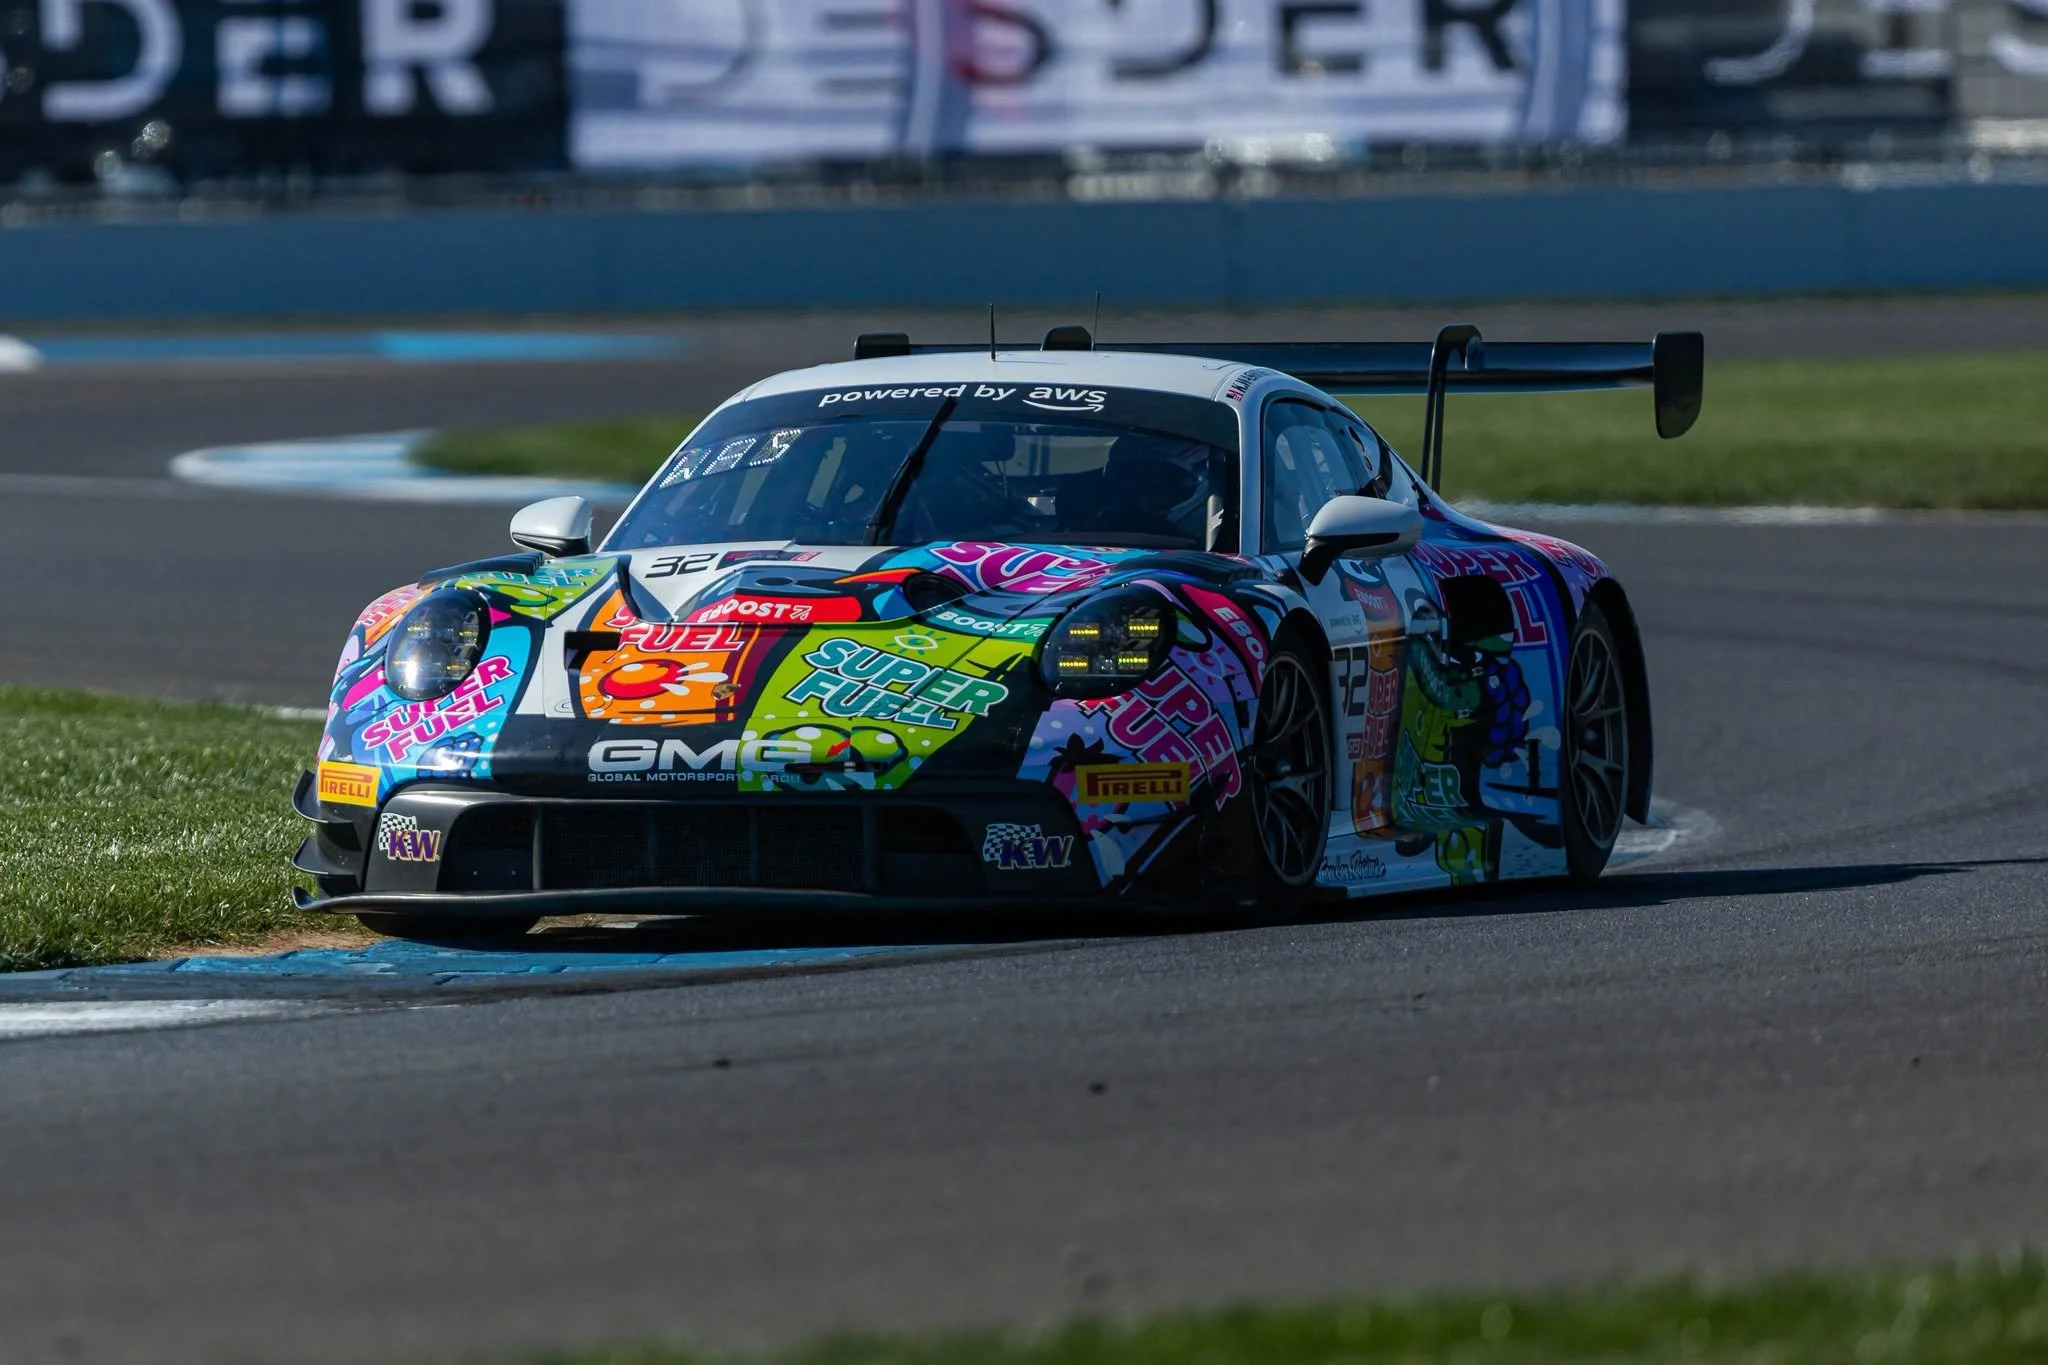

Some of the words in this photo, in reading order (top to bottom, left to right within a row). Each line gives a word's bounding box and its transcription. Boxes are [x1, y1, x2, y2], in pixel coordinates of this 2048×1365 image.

[818, 384, 967, 408] powered
[974, 384, 1017, 401] by
[1028, 386, 1108, 404] aws
[645, 552, 718, 578] 32
[697, 600, 790, 625] EBOOST
[617, 621, 744, 652] FUEL
[803, 638, 1009, 717] SUPER
[386, 686, 506, 763] FUEL
[587, 738, 812, 774] GMG
[320, 768, 374, 799] PIRELLI
[587, 772, 641, 783] GLOBAL
[1087, 768, 1180, 797] PIRELLI
[387, 828, 441, 863] KW
[997, 834, 1074, 869] KW
